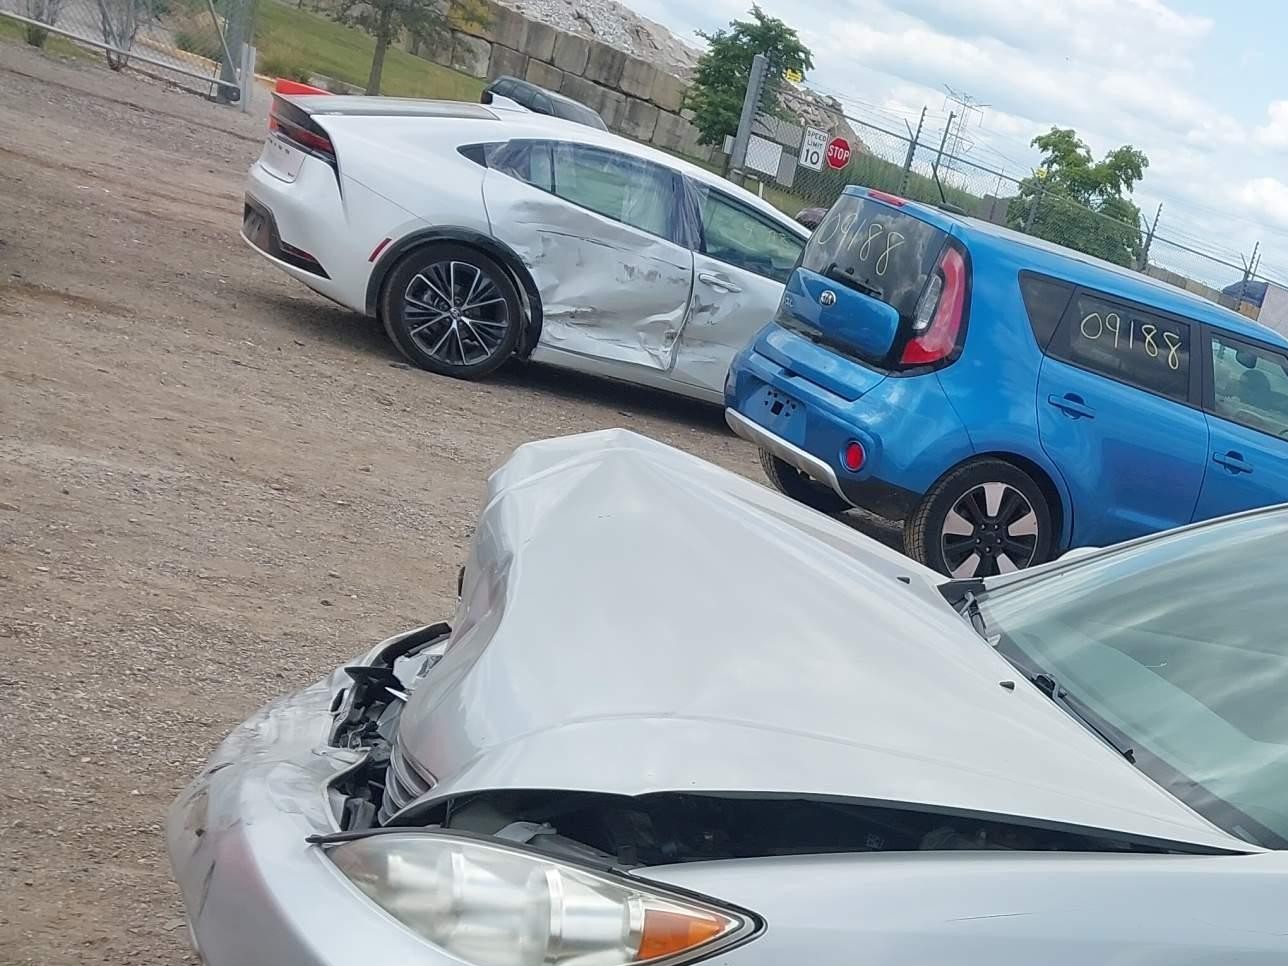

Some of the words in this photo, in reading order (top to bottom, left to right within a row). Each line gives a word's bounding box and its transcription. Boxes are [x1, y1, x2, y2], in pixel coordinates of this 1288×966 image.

[807, 130, 827, 142] SPEED
[807, 139, 823, 149] LIMIT
[804, 148, 820, 165] 10
[827, 144, 850, 161] STOP
[817, 212, 905, 276] 09188
[1080, 312, 1182, 370] 09188
